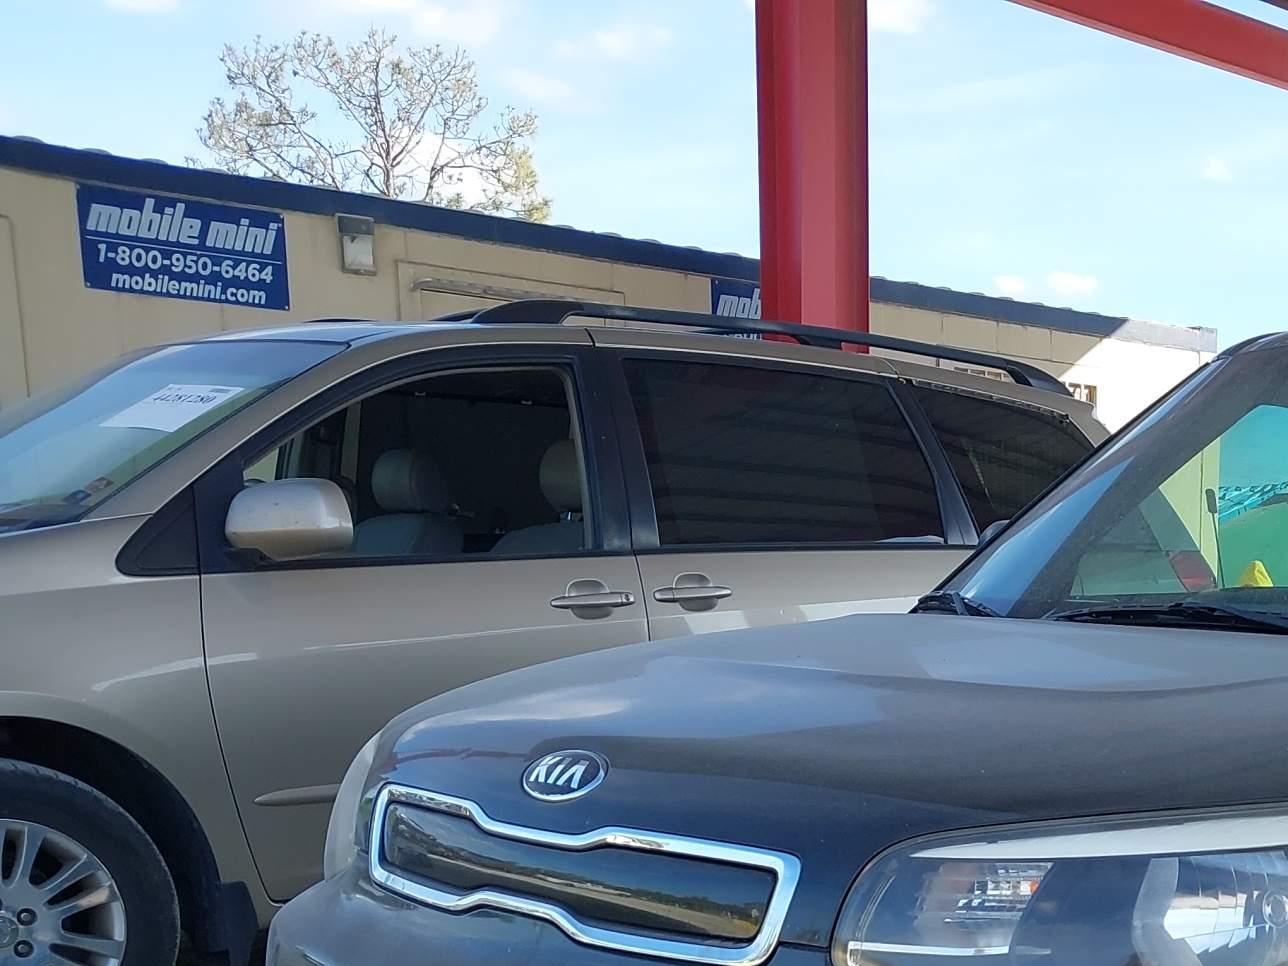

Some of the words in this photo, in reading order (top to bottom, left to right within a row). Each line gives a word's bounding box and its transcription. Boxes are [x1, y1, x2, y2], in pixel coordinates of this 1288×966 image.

[86, 198, 201, 245] mobile
[205, 218, 278, 255] mini
[97, 244, 273, 284] 1-800-950-6464
[111, 273, 266, 305] mobilemini.com
[529, 756, 590, 790] KIA
